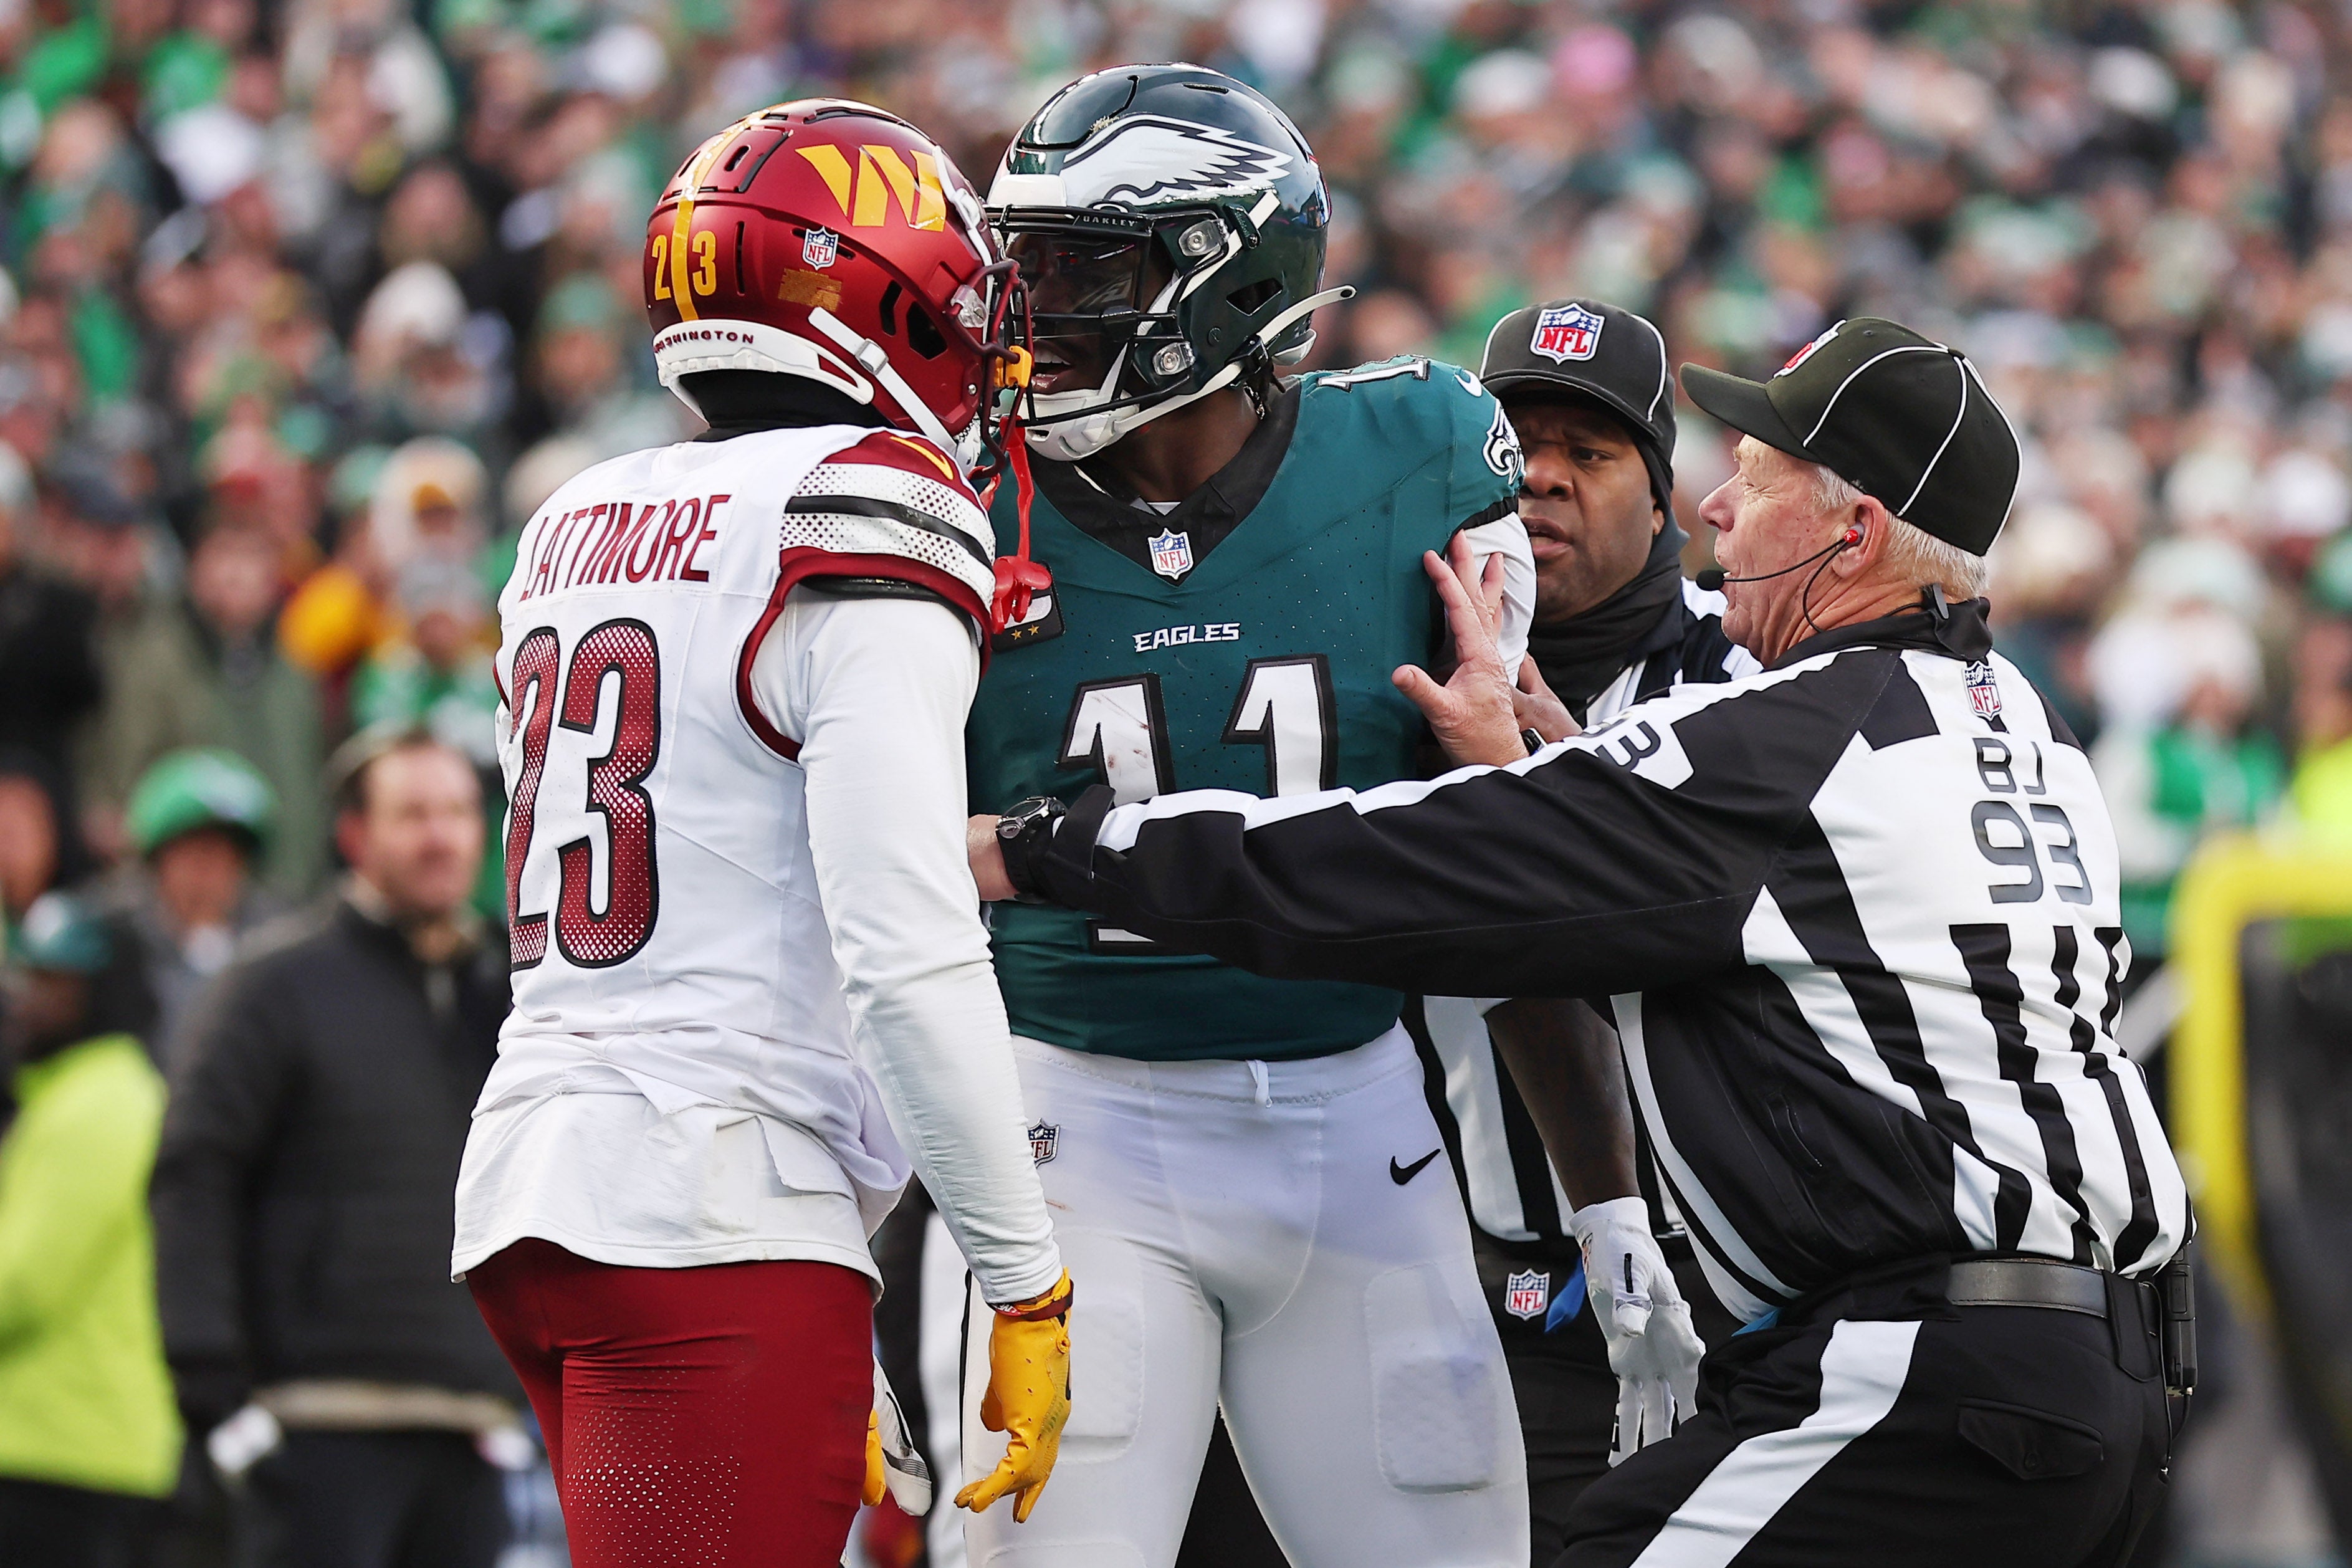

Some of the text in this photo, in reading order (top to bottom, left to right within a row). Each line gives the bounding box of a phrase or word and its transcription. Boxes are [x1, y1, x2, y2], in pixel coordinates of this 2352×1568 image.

[1083, 215, 1135, 227] OAKLEY
[808, 244, 830, 262] NFL
[1538, 327, 1588, 354] NFL
[519, 494, 732, 603] LATTIMORE
[1158, 550, 1187, 569] NFL
[1132, 622, 1241, 653] EAGLES
[1969, 687, 2000, 713] NFL
[1972, 737, 2047, 795] BJ
[505, 618, 661, 970] 23
[1970, 800, 2093, 906] 93
[1513, 1291, 1542, 1311] NFL
